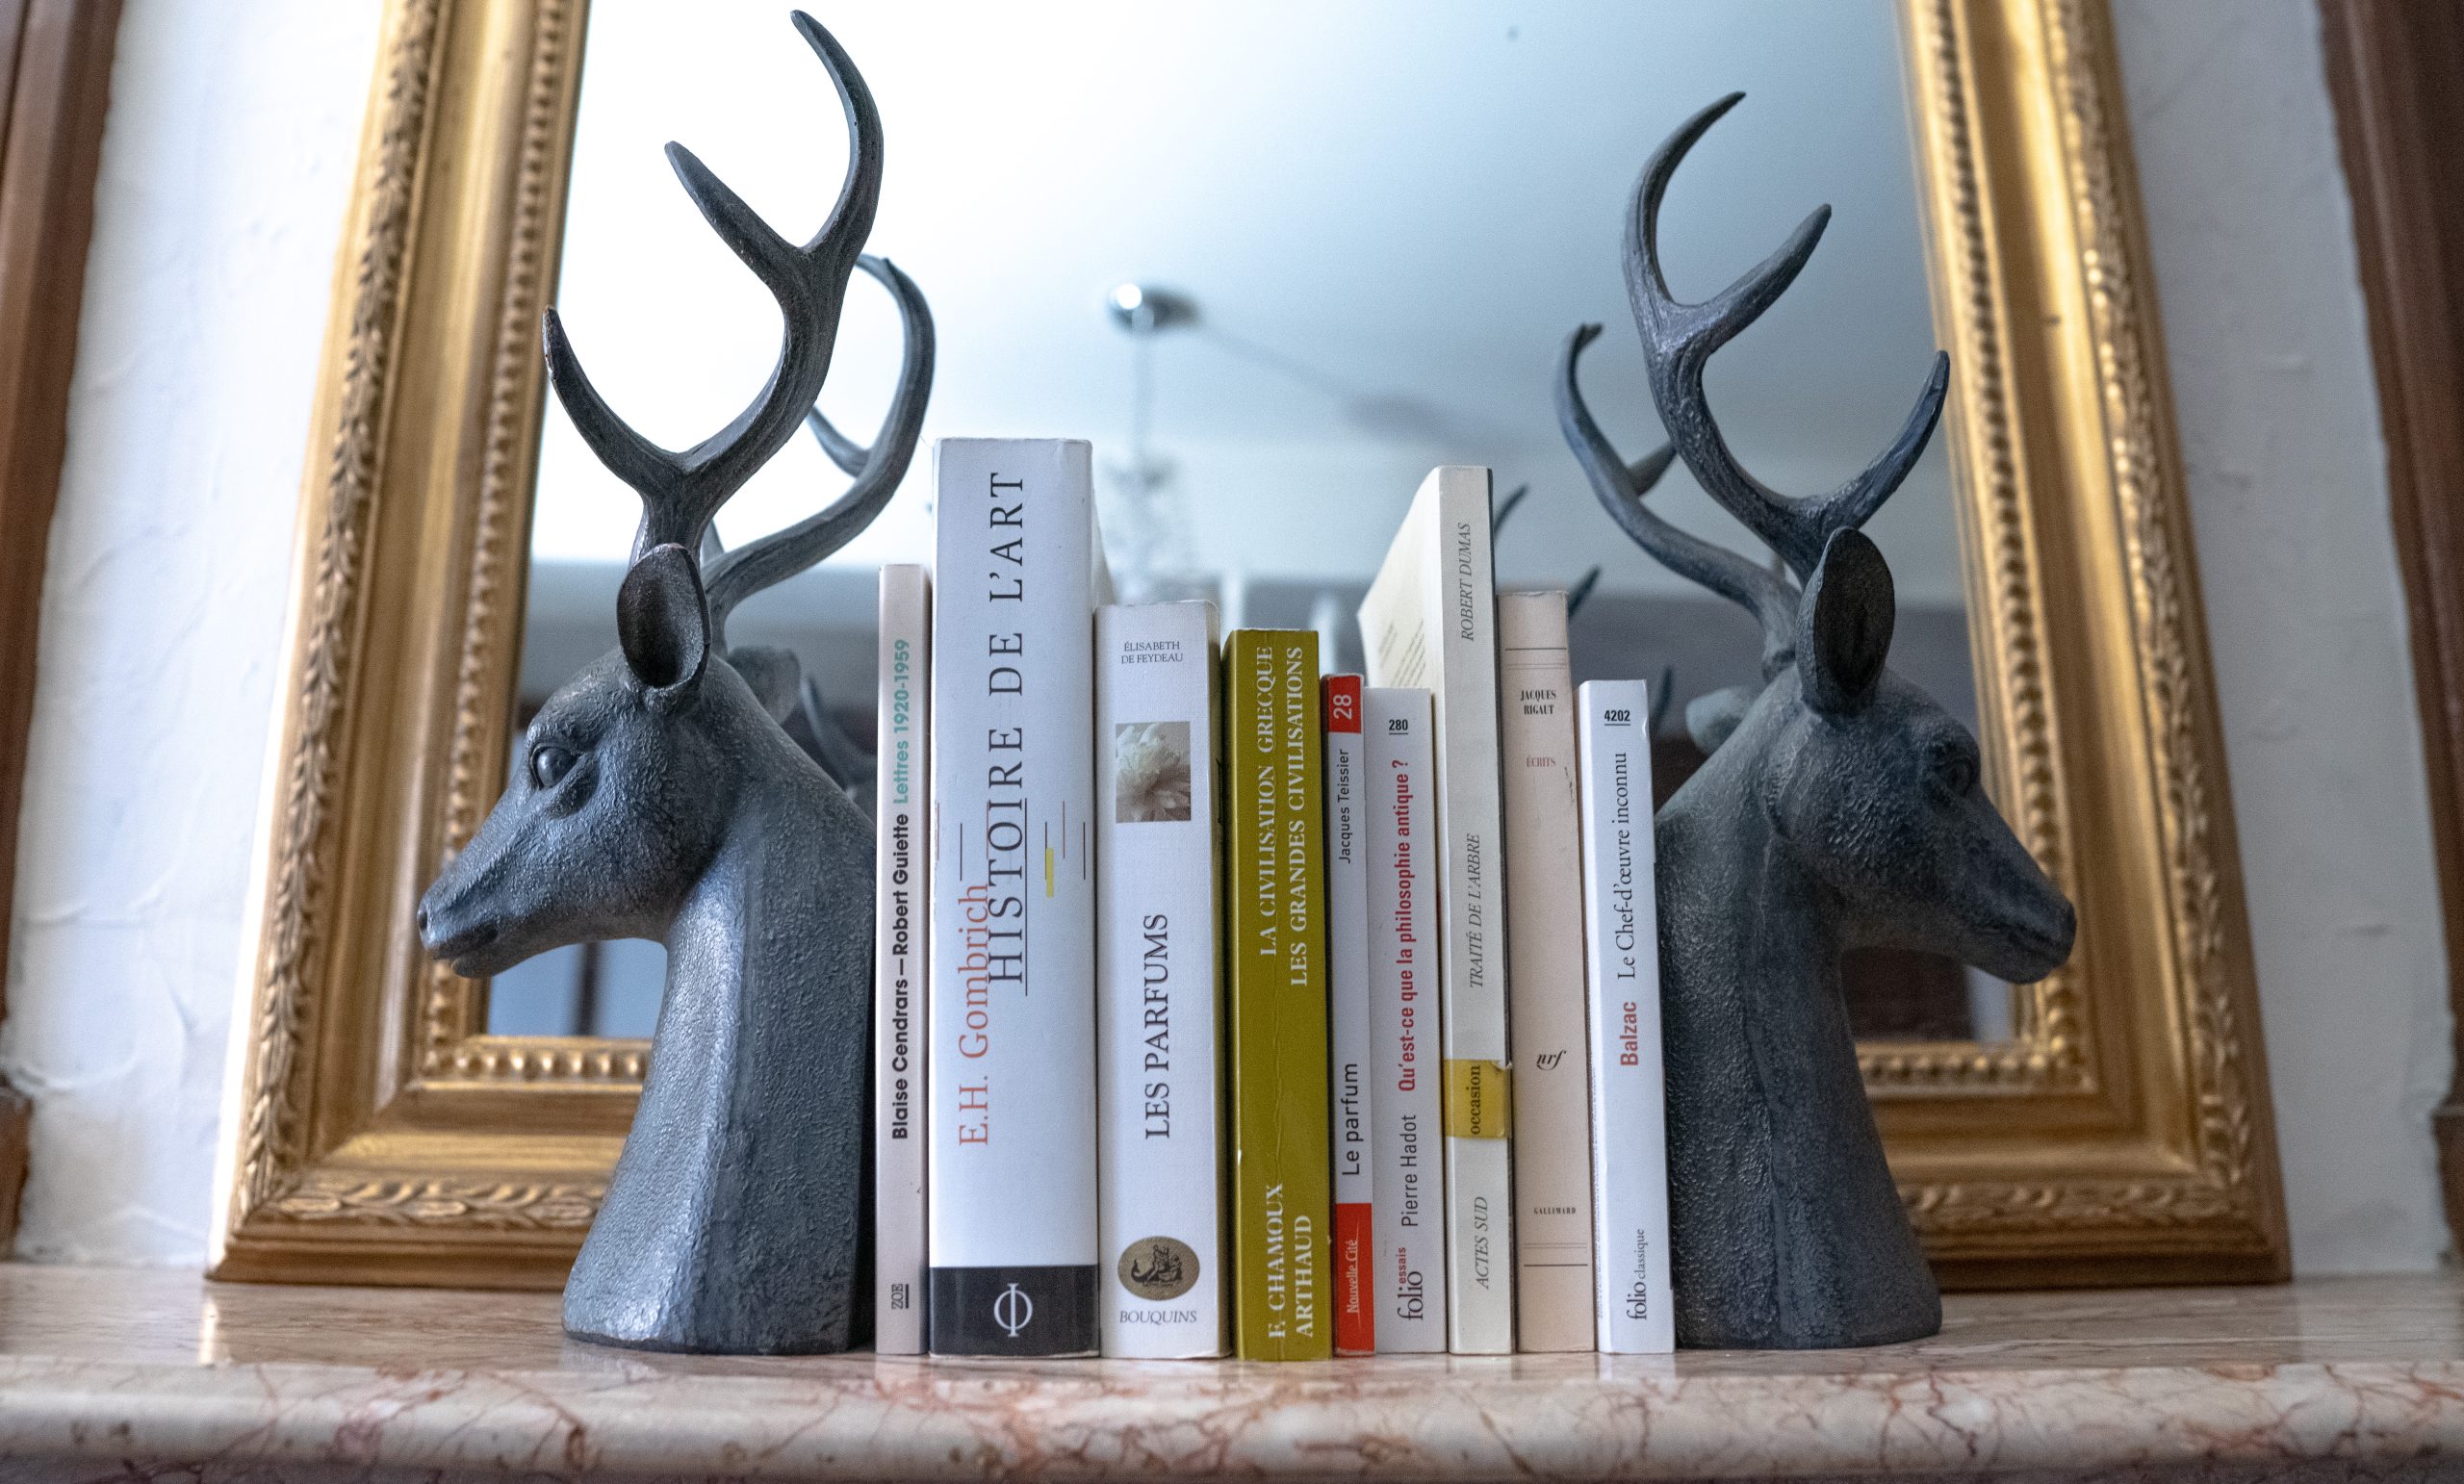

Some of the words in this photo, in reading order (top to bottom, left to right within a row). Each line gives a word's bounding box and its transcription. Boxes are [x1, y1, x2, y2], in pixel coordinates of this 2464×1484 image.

[988, 473, 1023, 602] L'ART
[1457, 523, 1472, 576] DUMAS
[1460, 578, 1475, 642] ROBERT
[988, 632, 1023, 696] DE
[1121, 654, 1135, 664] DE
[1137, 652, 1184, 663] FEYDEAU
[1124, 641, 1180, 652] ÉLISABETH
[893, 639, 910, 733] 1920-1959
[1256, 647, 1276, 753] GRECQUE
[1333, 694, 1352, 720] 28
[1520, 690, 1556, 701] JACQUES
[1524, 704, 1554, 715] RIGAUT
[1286, 647, 1304, 811] CIVILISATIONS
[1388, 719, 1408, 731] 280
[1604, 709, 1631, 722] 4202
[893, 740, 909, 804] Lettres
[1337, 749, 1349, 803] Teissier
[1526, 755, 1556, 767] ÉCRITS
[1611, 753, 1630, 824] inconnu
[1393, 774, 1413, 836] antique
[892, 813, 909, 884] Guiette
[988, 728, 1023, 985] HISTOIRE
[1257, 766, 1276, 917] CIVILISATION
[1339, 806, 1352, 863] Jacques
[1288, 820, 1306, 932] GRANDES
[1395, 844, 1416, 942] philosophie
[1466, 833, 1481, 900] L'ARBRE
[892, 890, 909, 956] Robert
[1260, 929, 1276, 956] LA
[1469, 903, 1482, 929] DE
[958, 883, 988, 1060] Gombrich
[1290, 942, 1307, 985] LES
[1397, 949, 1412, 963] la
[1466, 930, 1484, 988] TRAITÉ
[1618, 957, 1635, 980] Le
[1143, 914, 1169, 1072] PARFUMS
[1401, 970, 1418, 1001] que
[892, 979, 909, 1073] Cendrars
[1399, 1008, 1416, 1091] Qu'est-ce
[1620, 1002, 1639, 1066] Balzac
[1536, 1050, 1566, 1071] nrf
[892, 1079, 909, 1139] Blaise
[959, 1076, 988, 1146] E.H.
[1144, 1083, 1169, 1139] LES
[1341, 1063, 1363, 1141] parfum
[1466, 1064, 1481, 1135] occasion
[1342, 1150, 1359, 1176] Le
[1399, 1114, 1417, 1167] Hadot
[1400, 1173, 1418, 1227] Pierre
[1473, 1196, 1489, 1232] SUD
[1266, 1184, 1285, 1311] CHAMOUX
[1345, 1239, 1358, 1257] Cité
[1396, 1246, 1407, 1283] essais
[1474, 1236, 1489, 1290] ACTES
[1635, 1229, 1649, 1279] classique
[890, 1283, 905, 1310] ZOE
[1295, 1215, 1313, 1338] ARTHAUD
[1347, 1259, 1358, 1315] Nouvelle
[1398, 1271, 1423, 1321] folio
[1627, 1282, 1648, 1320] folio
[1119, 1310, 1197, 1326] BOUQUINS
